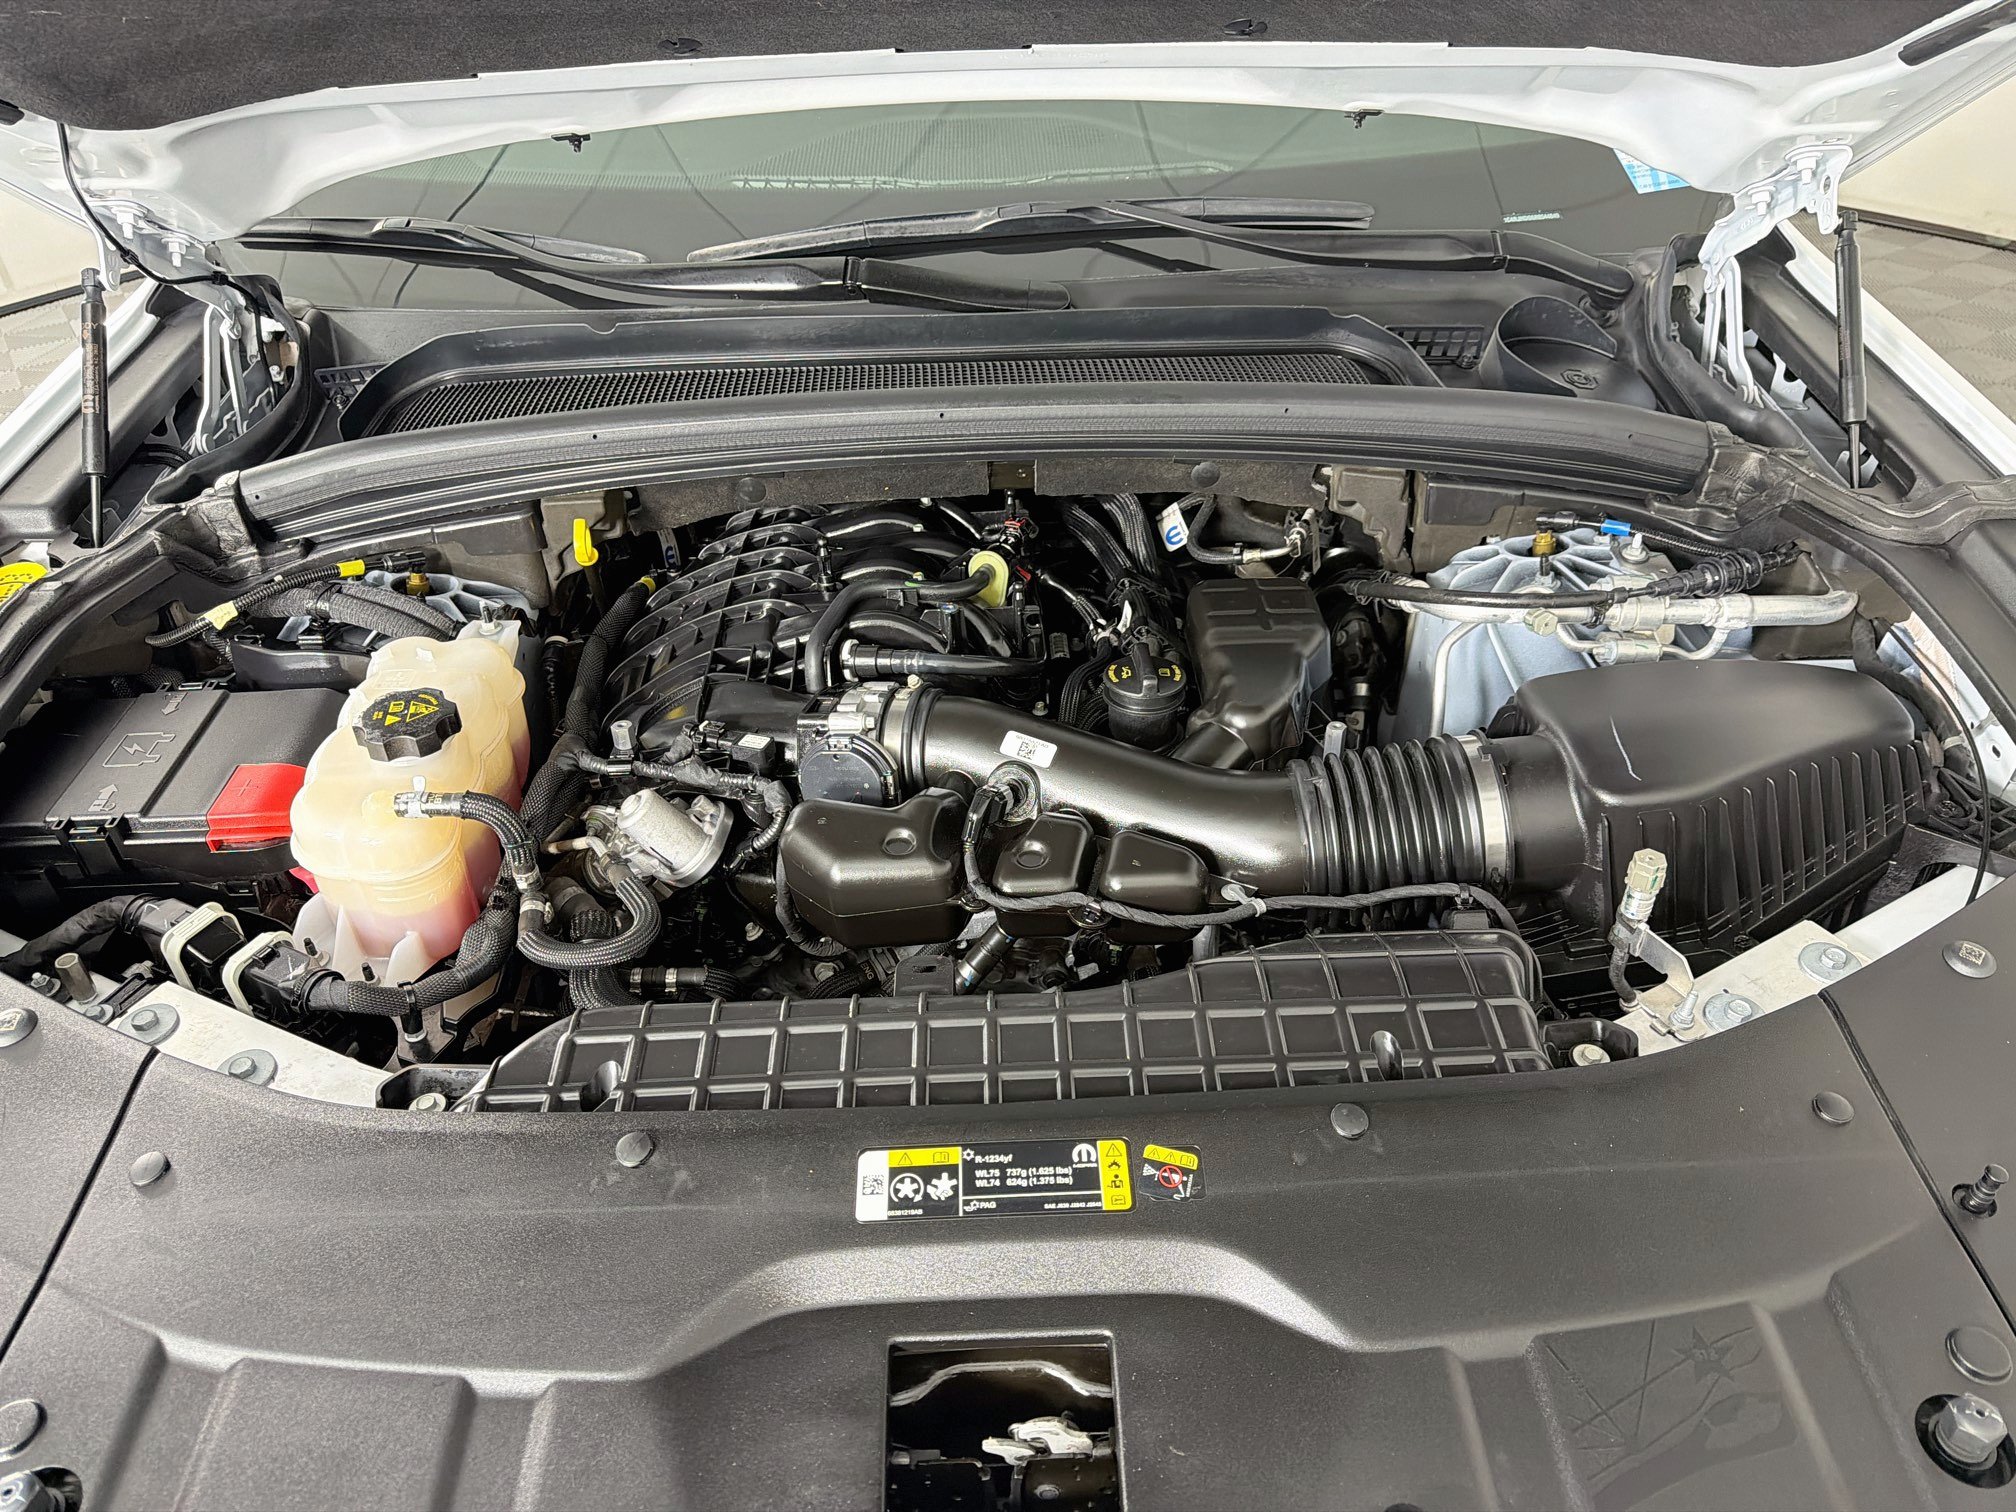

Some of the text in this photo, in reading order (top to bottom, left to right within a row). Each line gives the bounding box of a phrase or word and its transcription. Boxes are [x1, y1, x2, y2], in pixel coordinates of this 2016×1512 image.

[975, 1153, 1013, 1163] R-1234yf
[975, 1166, 1073, 1177] WL75 737g (1.625 lbs)
[975, 1176, 1073, 1187] WL74 624g (1.375 lbs)
[980, 1201, 996, 1209] PAG
